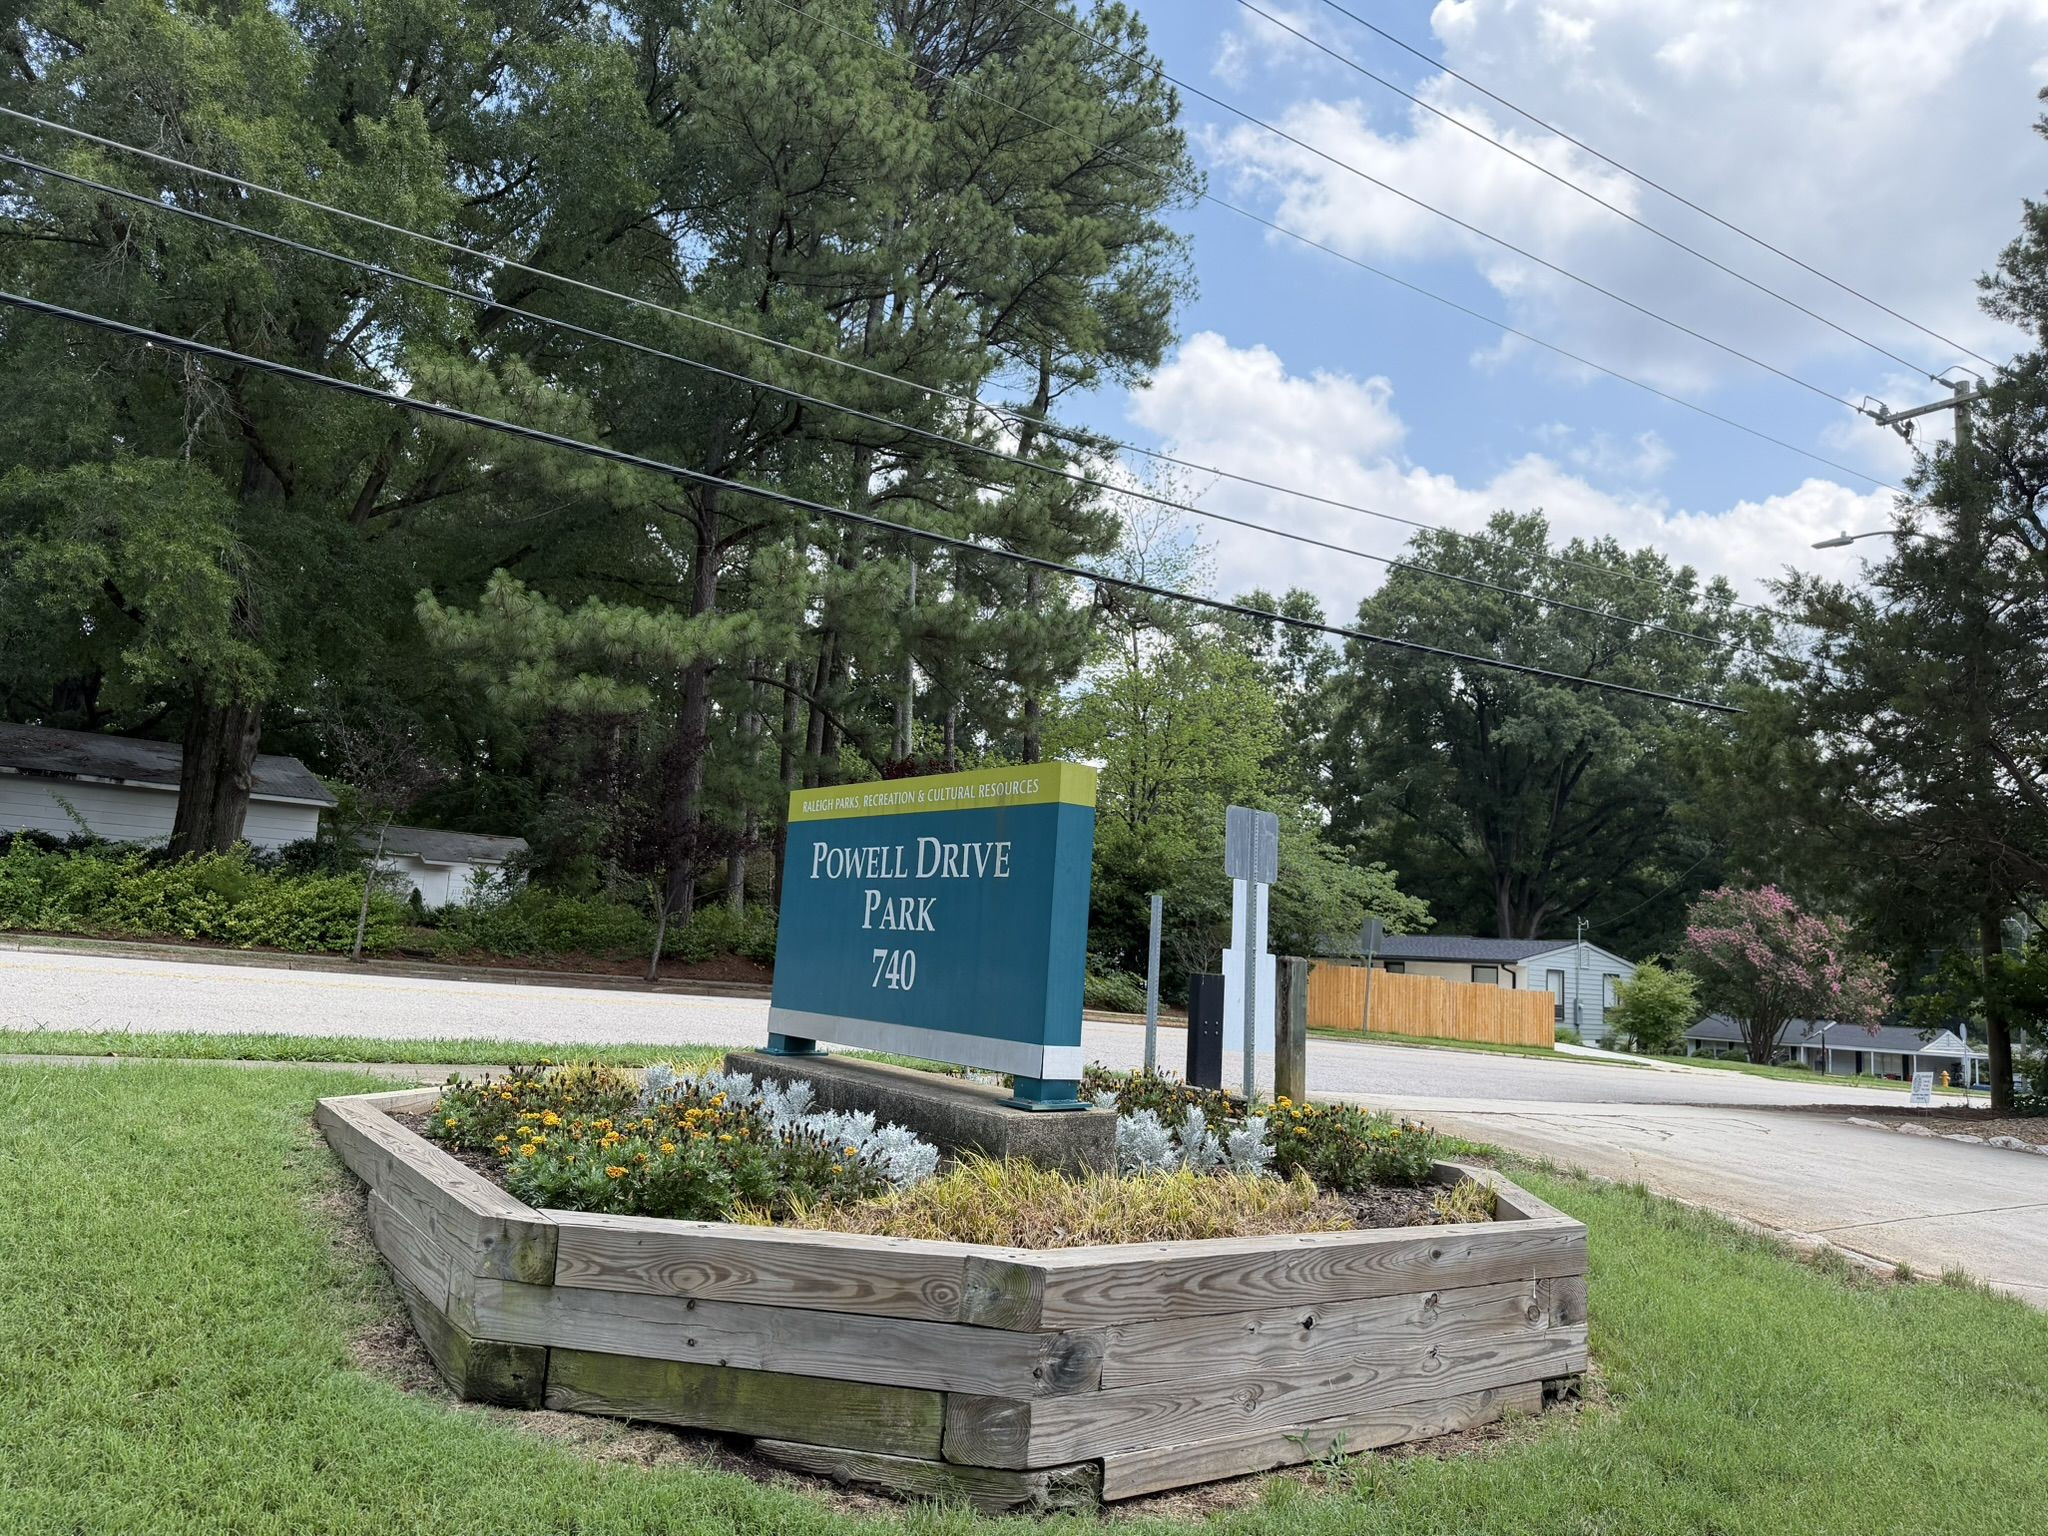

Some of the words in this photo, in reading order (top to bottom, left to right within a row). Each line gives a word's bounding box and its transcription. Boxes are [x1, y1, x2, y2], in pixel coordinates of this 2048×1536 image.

[803, 799, 833, 813] RALEIGH
[863, 791, 915, 807] RECREATION
[917, 789, 925, 803] &
[927, 785, 975, 802] CULTURAL
[978, 778, 1039, 798] RESOURCES
[810, 842, 908, 880] POWELL
[915, 837, 1011, 879] DRIVE
[861, 889, 937, 932] PARK
[872, 948, 916, 991] 740
